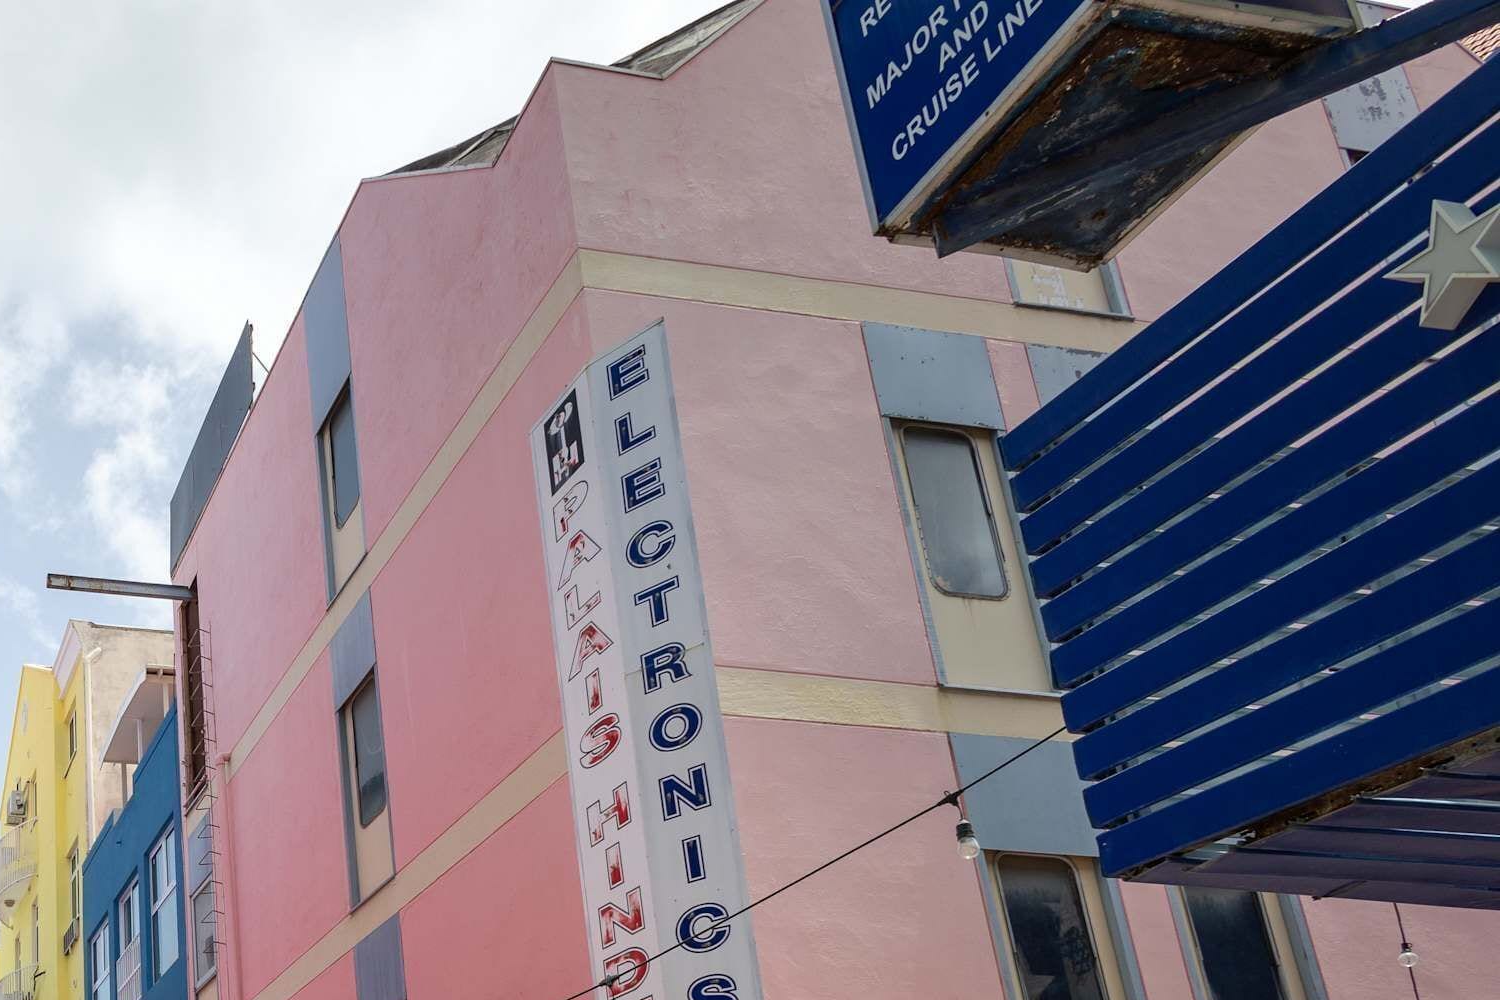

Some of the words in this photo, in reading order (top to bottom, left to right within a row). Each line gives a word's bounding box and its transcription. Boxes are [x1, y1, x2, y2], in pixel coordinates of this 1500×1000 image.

[866, 5, 949, 109] MAJOR
[938, 1, 989, 72] AND
[892, 53, 980, 161] CRUISE
[552, 479, 623, 769] PALAIS
